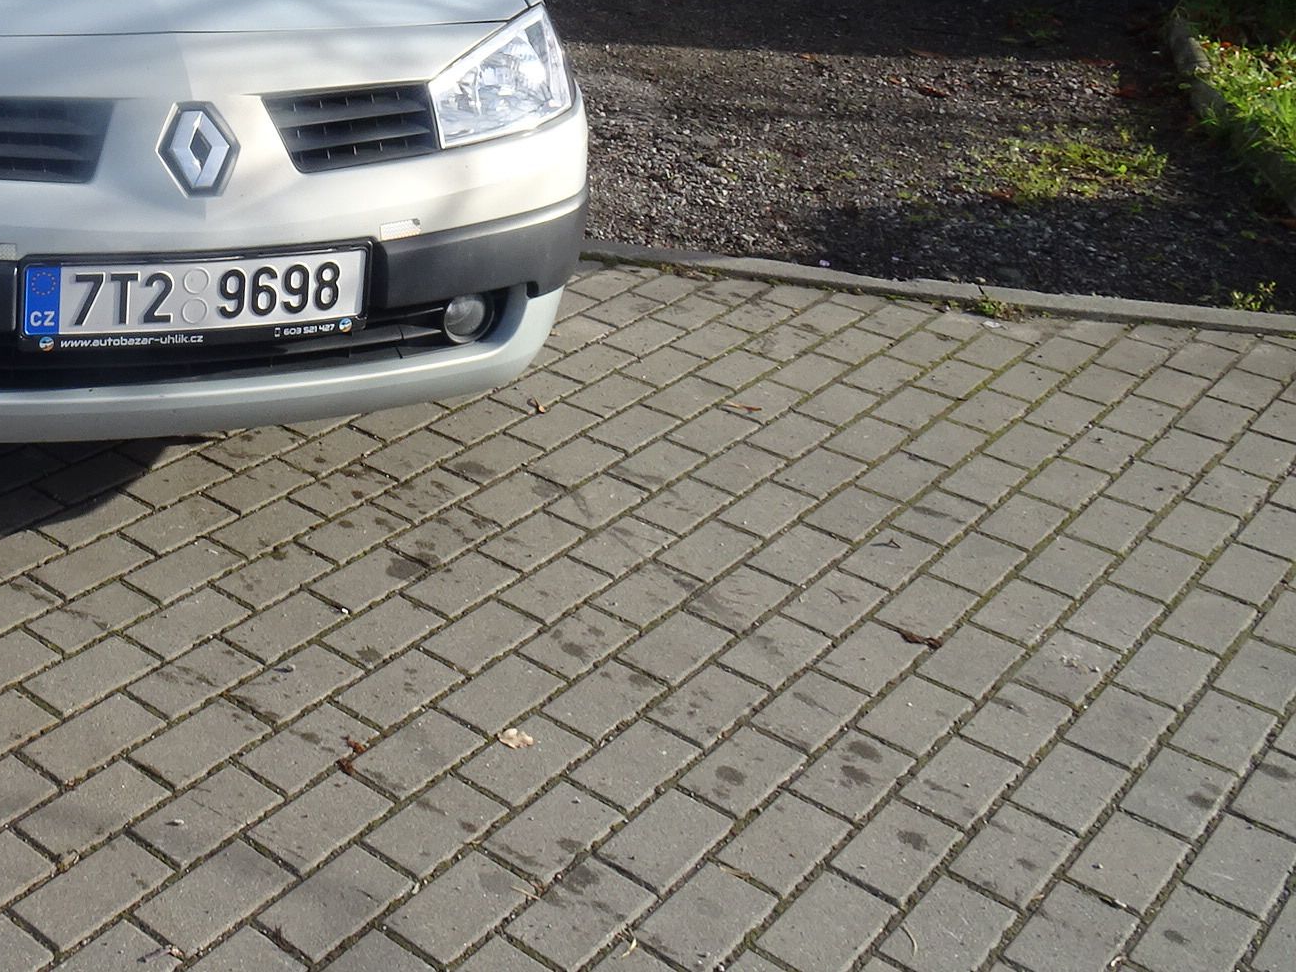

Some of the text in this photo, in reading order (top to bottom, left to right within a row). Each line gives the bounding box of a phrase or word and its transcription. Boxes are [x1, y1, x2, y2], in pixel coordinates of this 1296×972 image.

[73, 260, 342, 327] 7T2 9698
[29, 310, 55, 327] CZ
[283, 327, 302, 336] 603
[59, 334, 204, 349] www.autobazar-uhlik.cz
